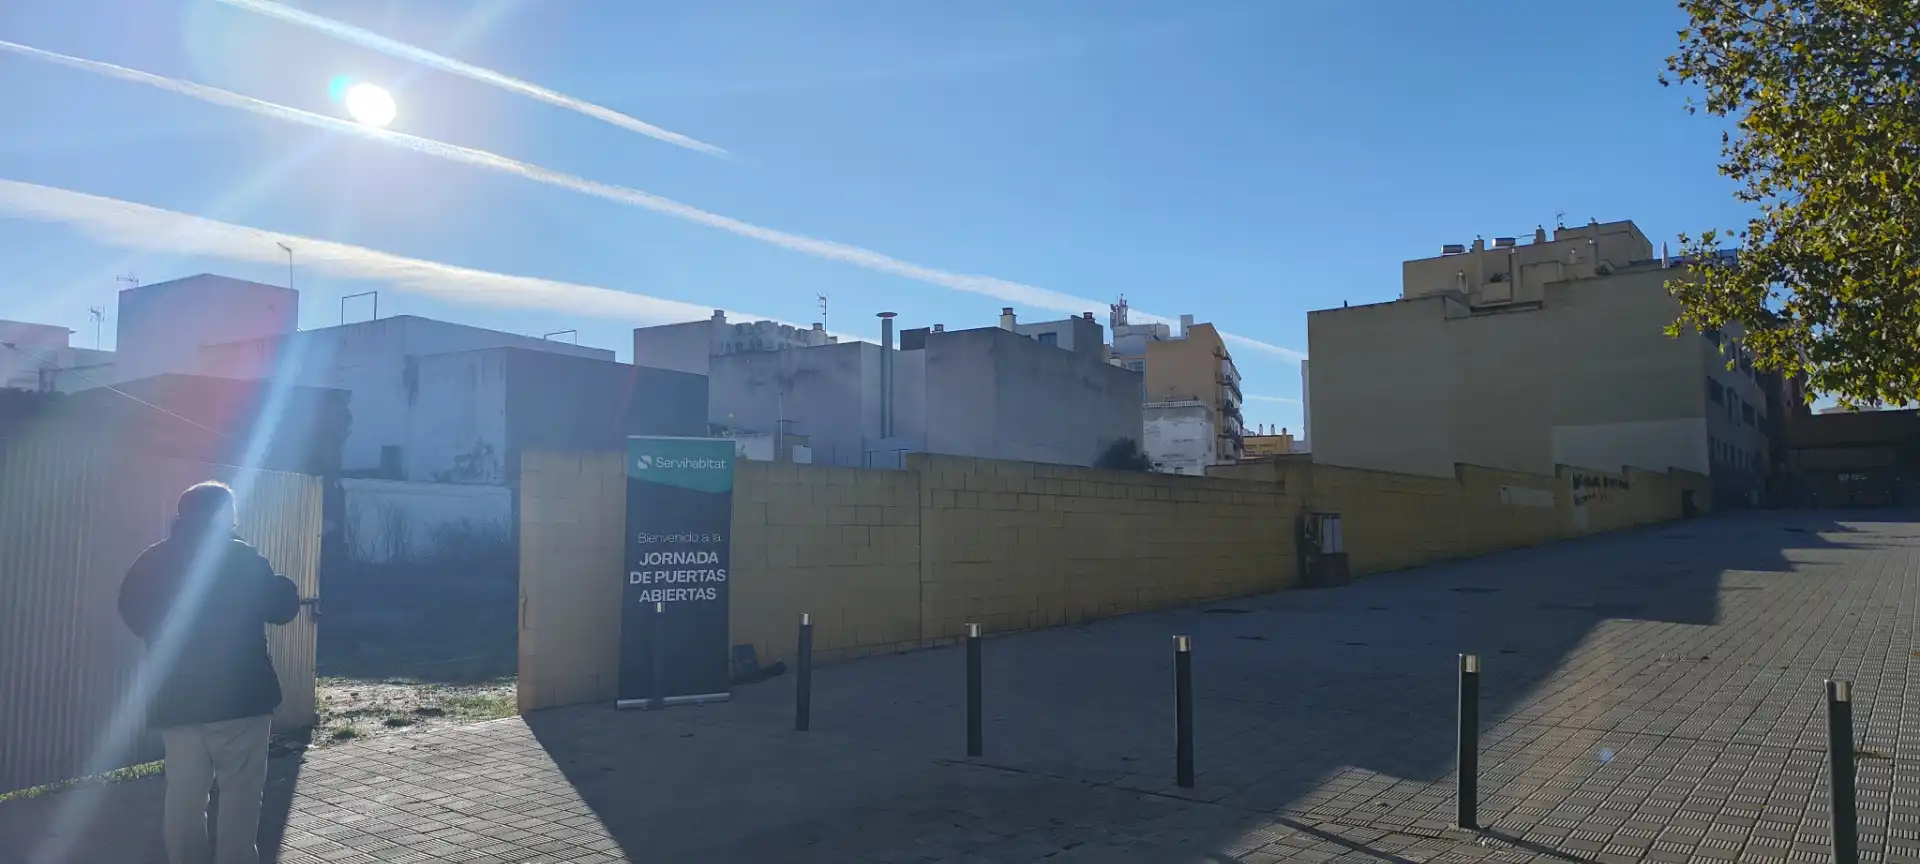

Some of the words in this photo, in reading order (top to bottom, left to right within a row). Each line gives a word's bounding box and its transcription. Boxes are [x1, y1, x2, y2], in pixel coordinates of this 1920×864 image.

[656, 456, 726, 469] Servihabitat
[638, 532, 699, 544] Bienvenido
[700, 534, 709, 543] a
[712, 532, 722, 542] la
[639, 551, 719, 566] JORNADA
[629, 571, 652, 584] DE
[655, 569, 726, 583] PUERTAS
[639, 587, 717, 603] ABIERTAS
